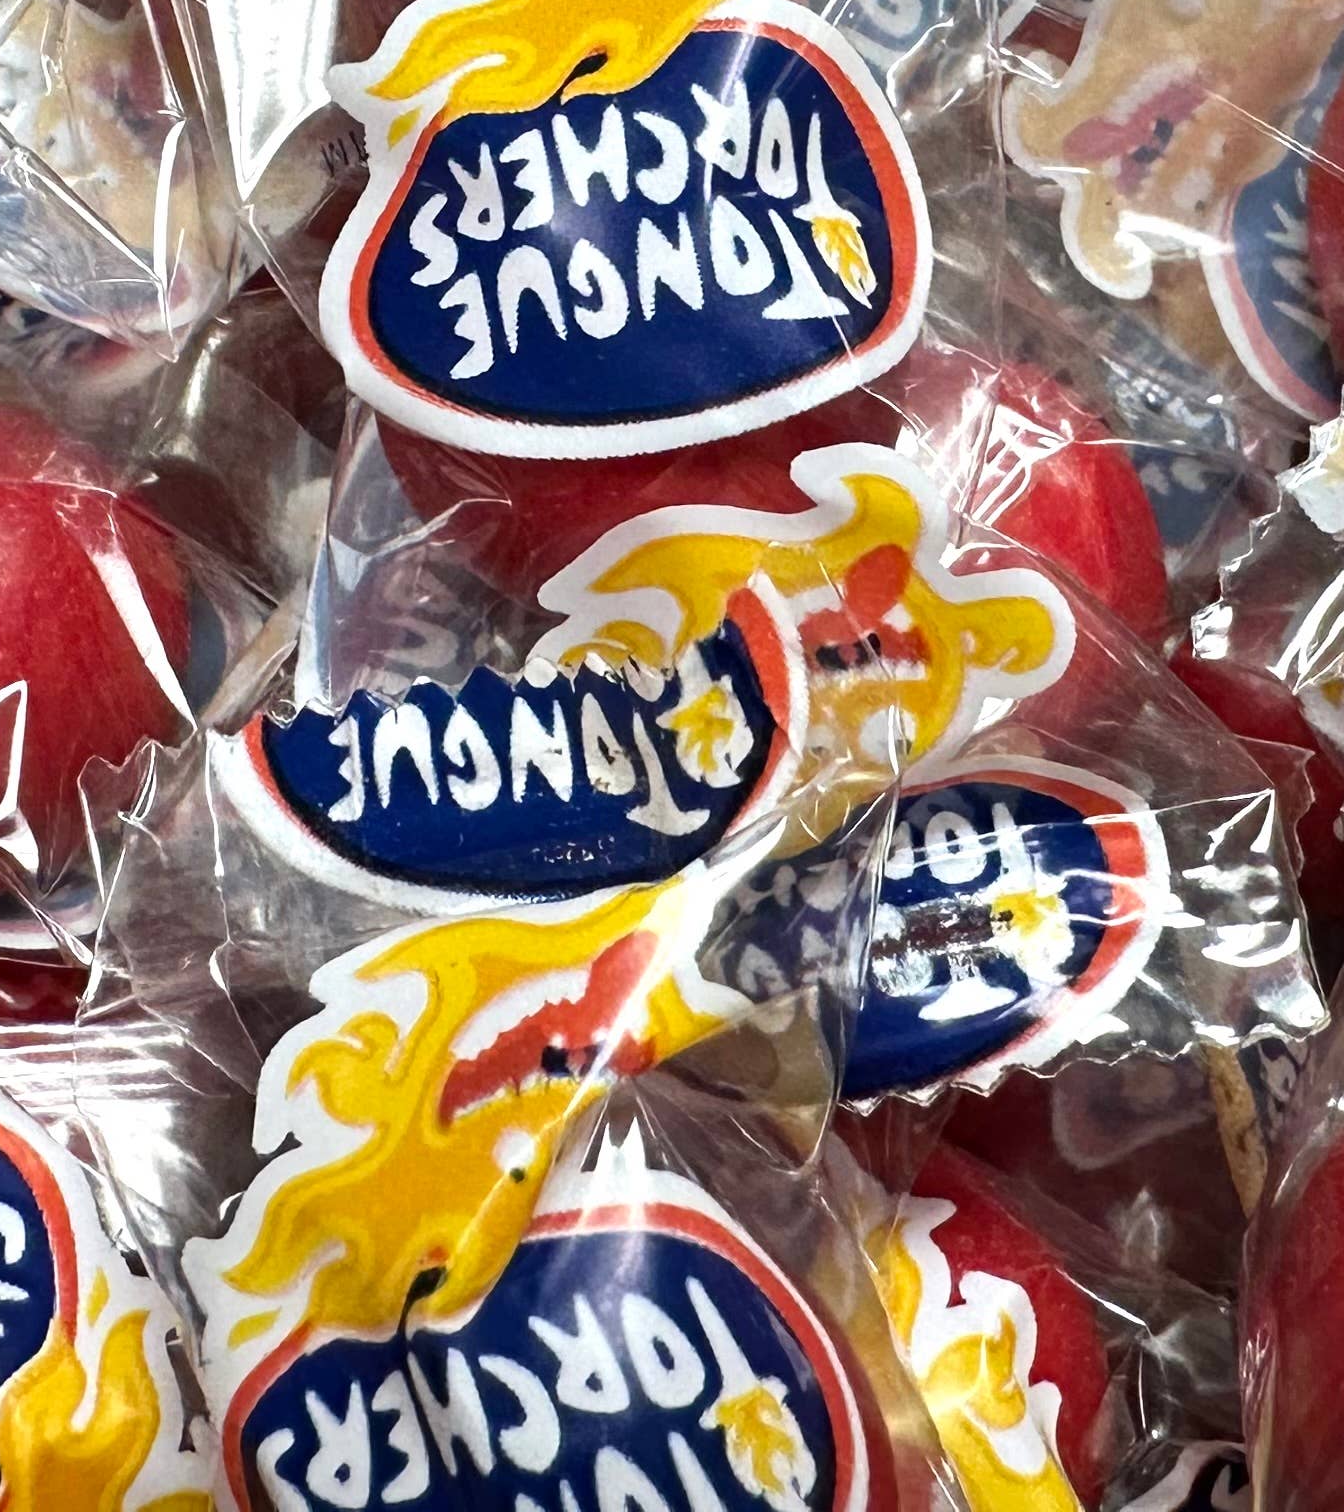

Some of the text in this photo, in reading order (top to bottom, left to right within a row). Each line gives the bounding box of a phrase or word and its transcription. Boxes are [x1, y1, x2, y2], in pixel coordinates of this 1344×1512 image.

[408, 81, 874, 303] TORCHERS
[438, 194, 850, 380] TONGUE
[327, 691, 713, 836] TONGUE
